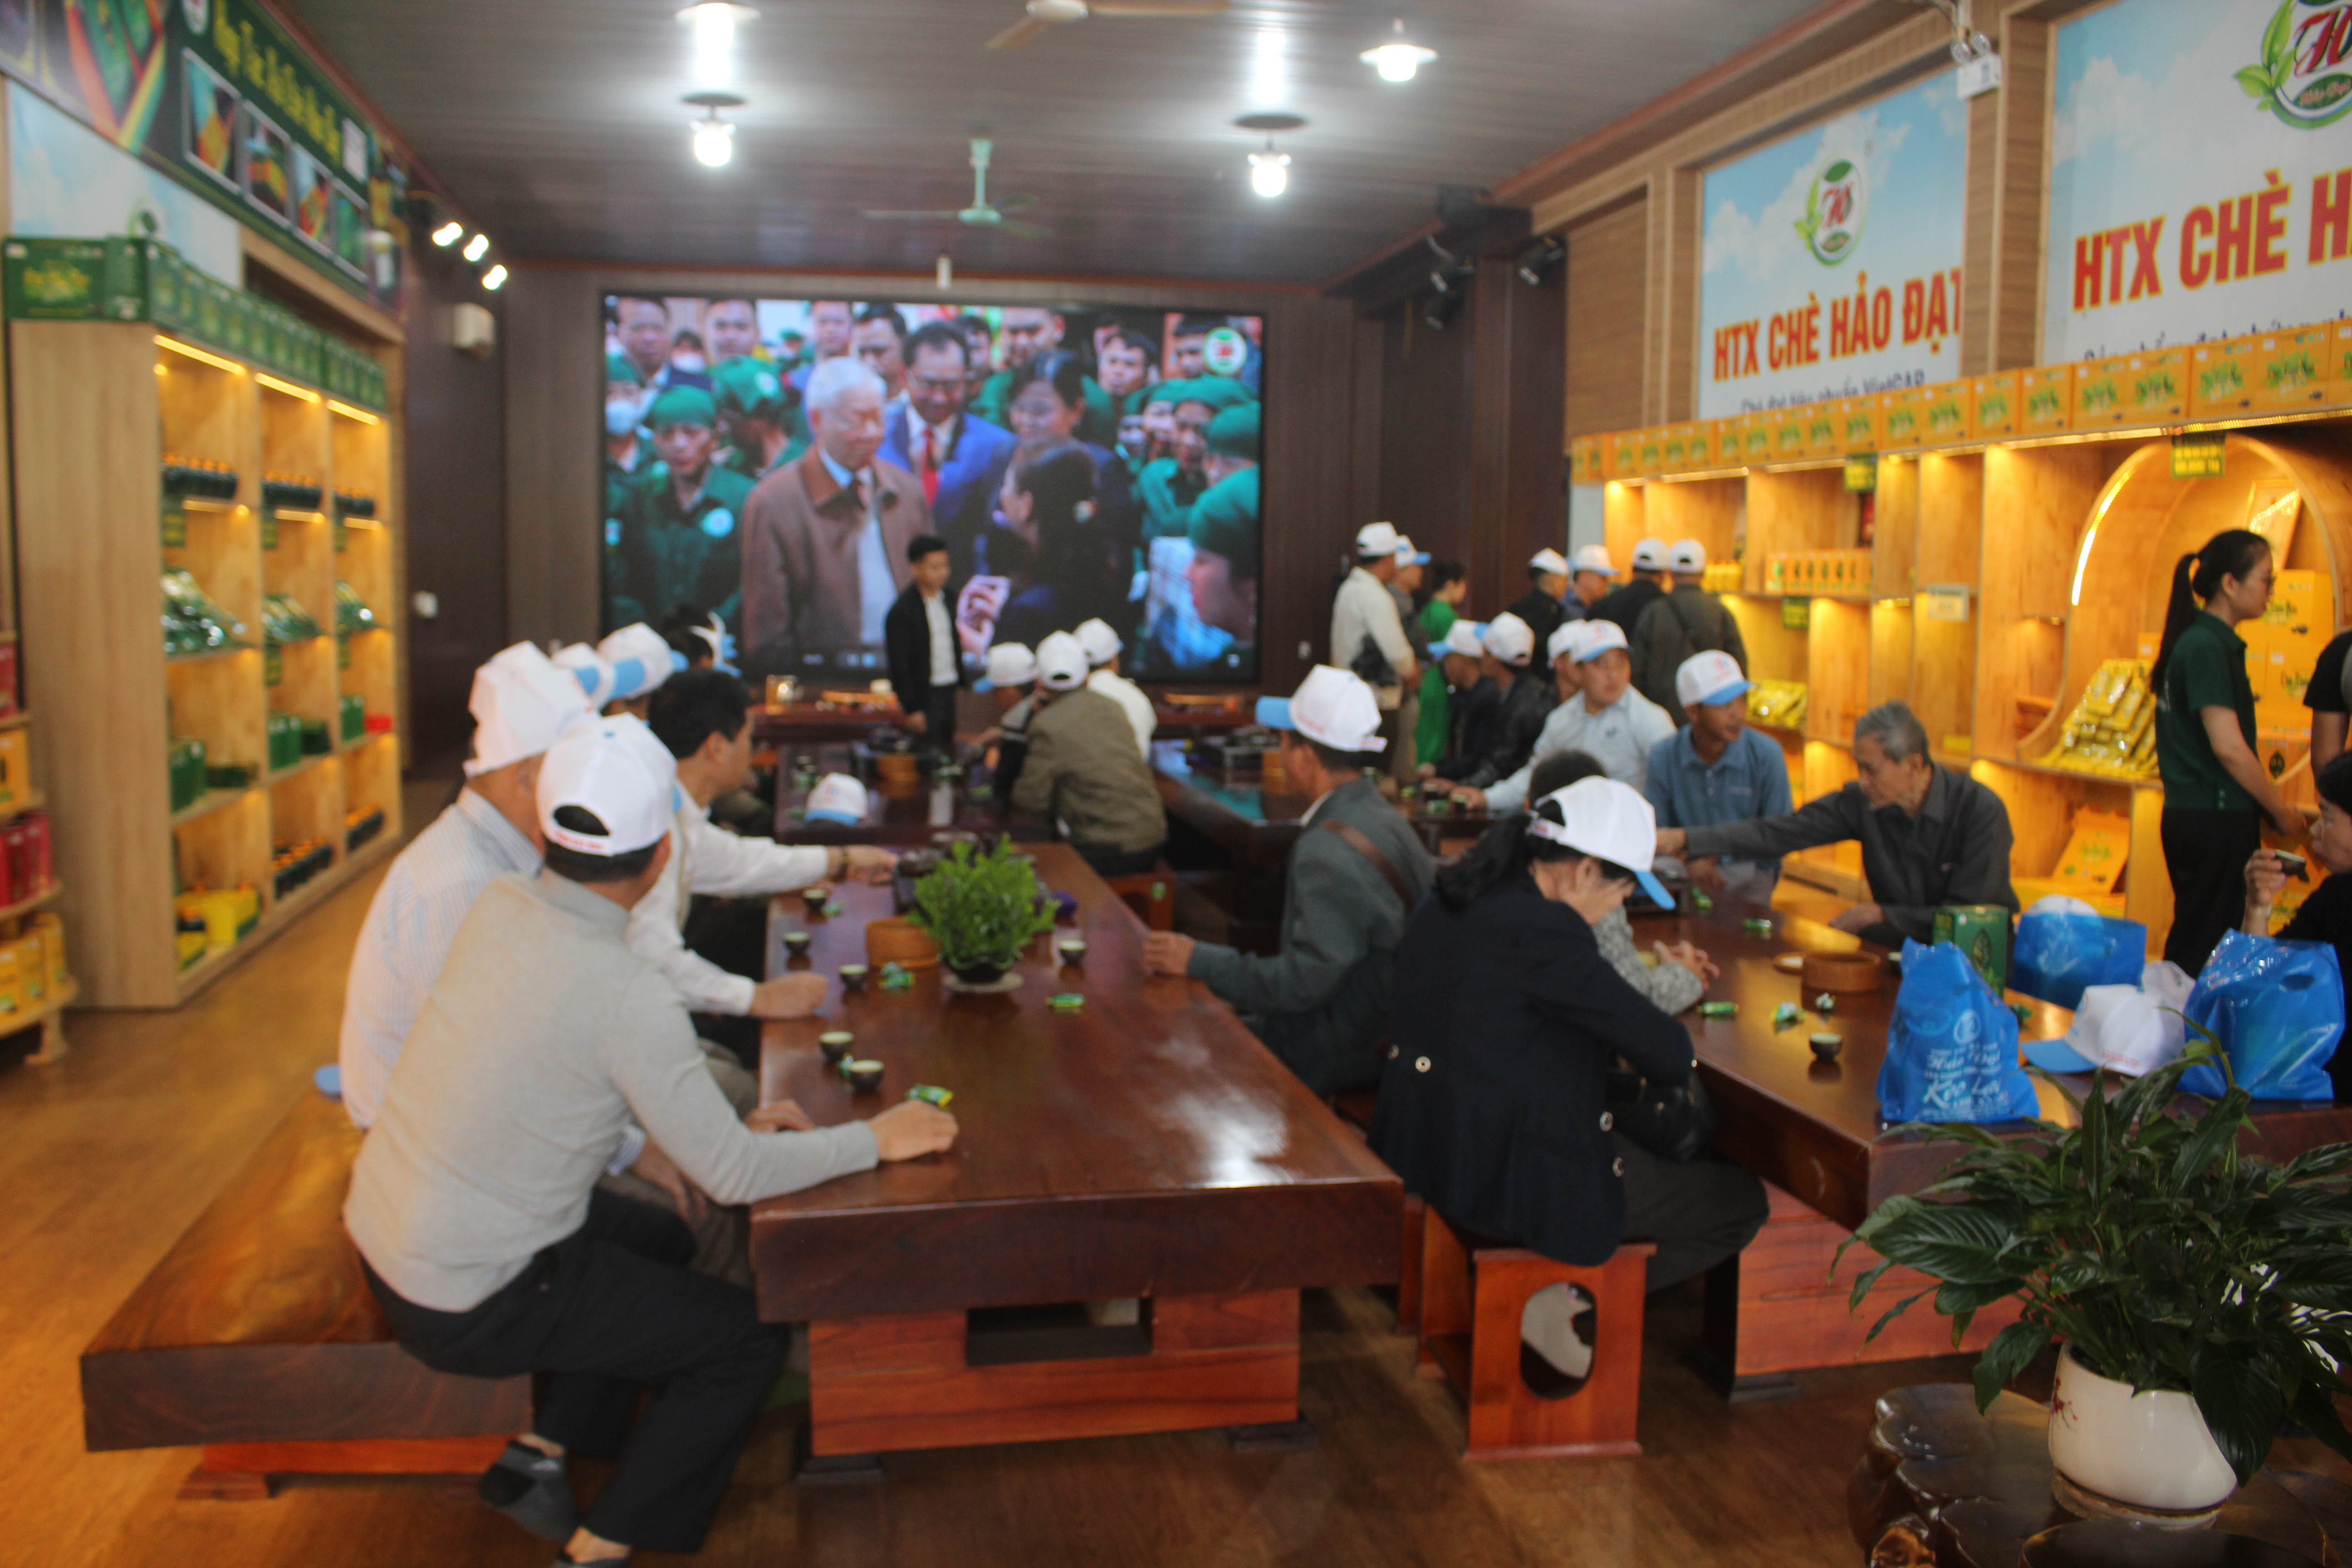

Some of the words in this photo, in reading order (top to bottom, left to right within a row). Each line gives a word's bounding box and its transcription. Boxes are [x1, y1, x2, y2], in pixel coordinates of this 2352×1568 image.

[2072, 214, 2166, 313] HTX
[2179, 167, 2292, 290] CHÈ
[2307, 165, 2352, 266] H
[1714, 316, 1760, 382] HTX
[1768, 290, 1820, 371] CHÈ
[1829, 270, 1892, 359] HẢO
